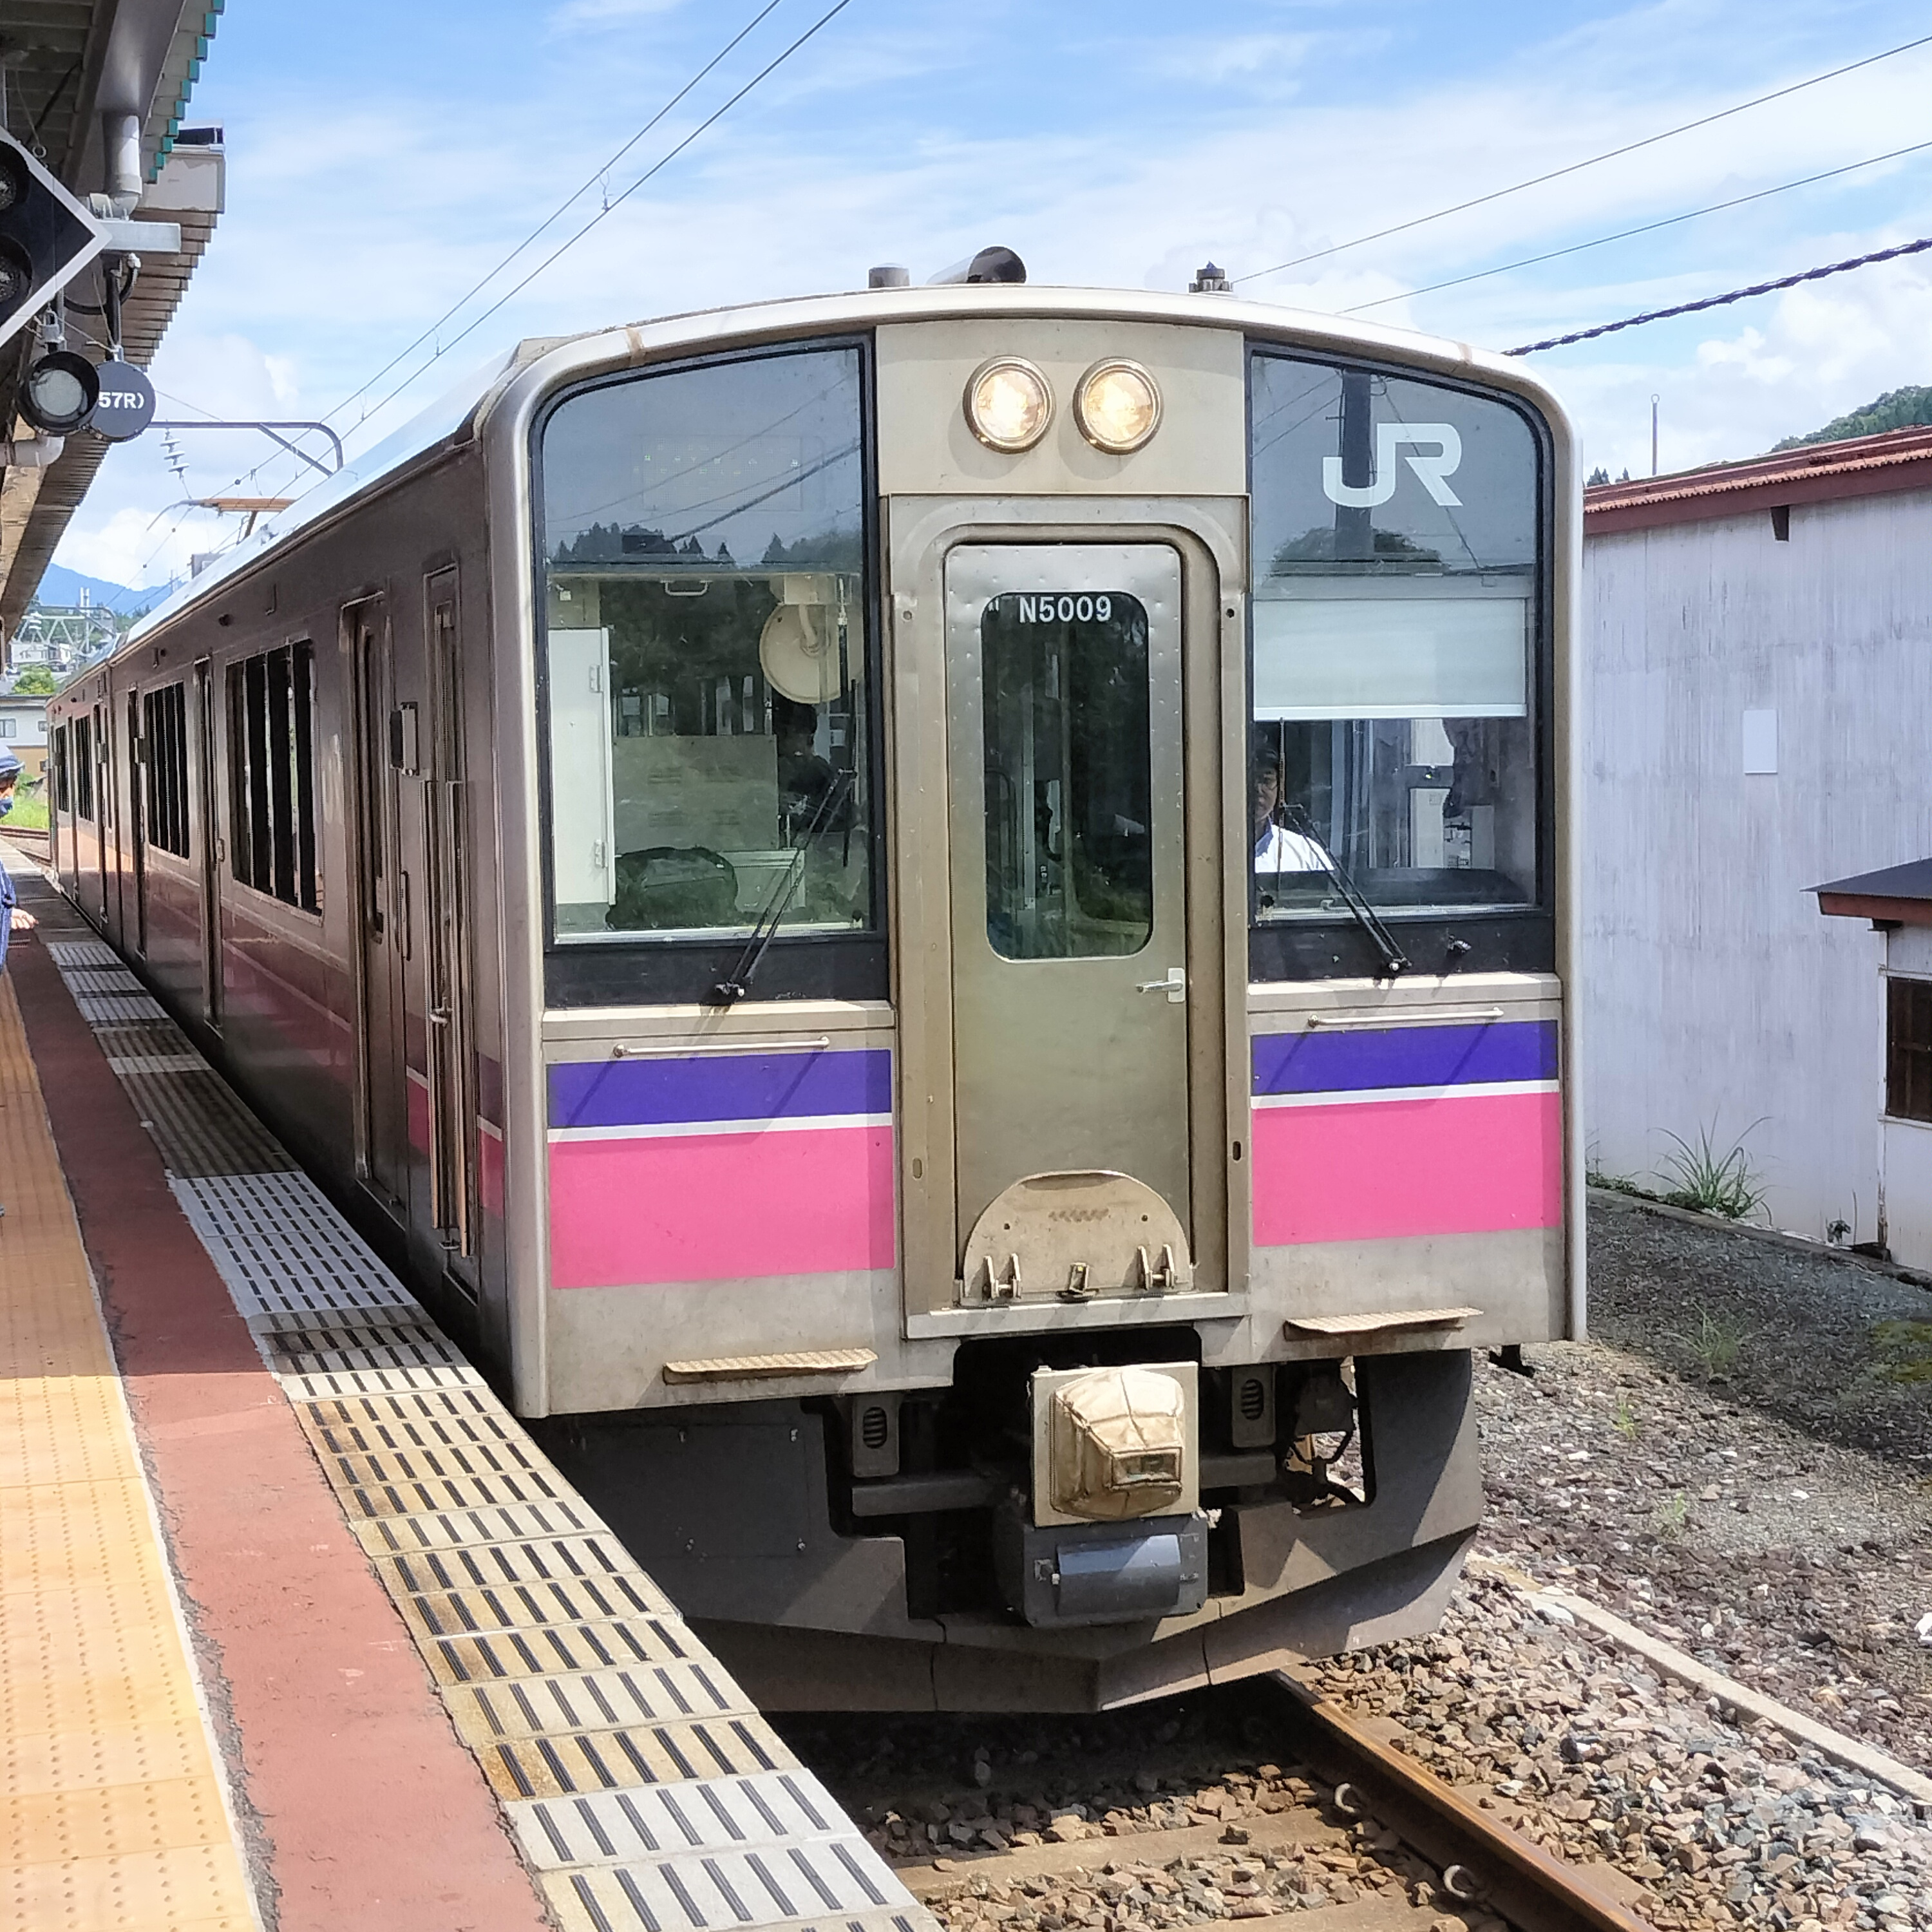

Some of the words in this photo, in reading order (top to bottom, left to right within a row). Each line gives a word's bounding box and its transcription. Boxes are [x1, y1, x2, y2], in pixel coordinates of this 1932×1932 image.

[99, 392, 144, 409] 57R)
[1323, 423, 1463, 507] JR
[1019, 596, 1112, 623] N5009
